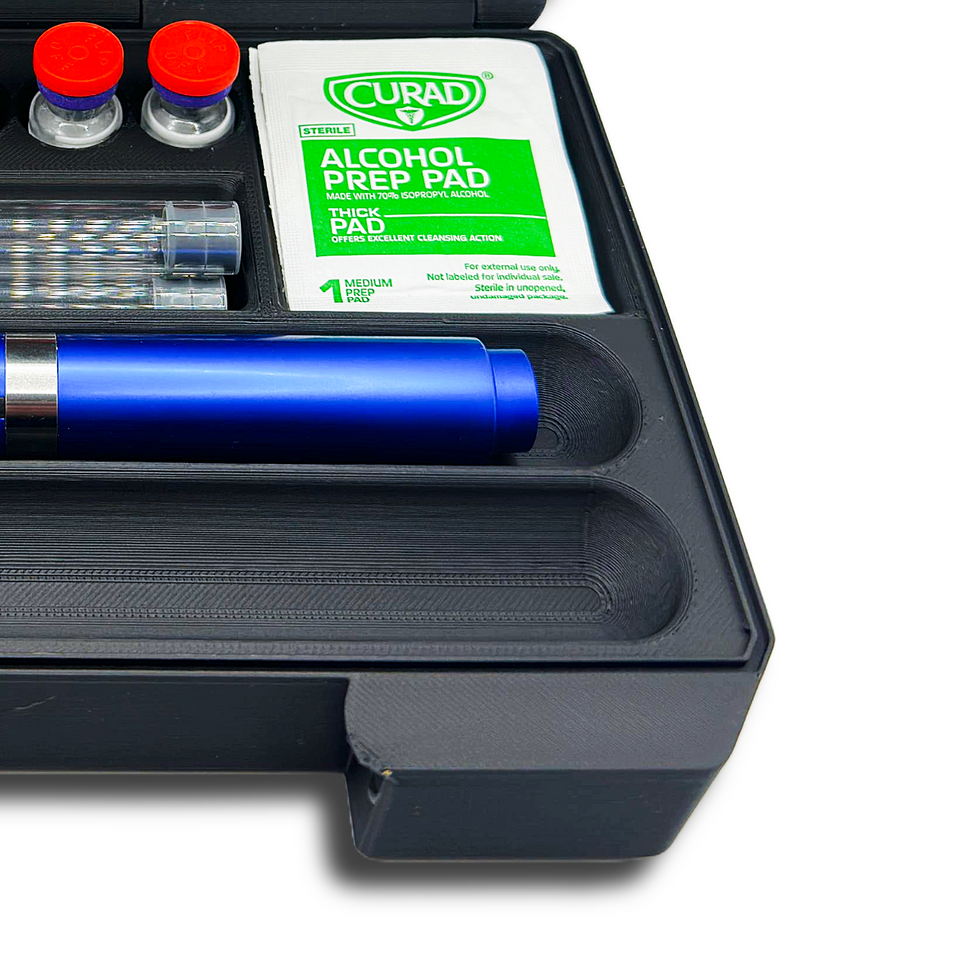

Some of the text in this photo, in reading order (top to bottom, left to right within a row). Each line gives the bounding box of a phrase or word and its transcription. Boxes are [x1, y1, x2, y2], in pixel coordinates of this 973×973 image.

[344, 81, 471, 108] CURAD
[303, 126, 351, 135] STERILE
[320, 146, 474, 168] ALCOHOL
[323, 168, 491, 191] PREP PAD
[326, 190, 490, 200] MADE WITH 70% ISOPROPYL ALCOHOL
[328, 207, 381, 218] THICK
[330, 217, 385, 235] PAD
[331, 234, 503, 243] OFFERS EXCELLENT CLEANSING ACTION
[481, 263, 518, 271] external
[426, 273, 444, 281] Not
[446, 273, 479, 281] labeled
[481, 273, 494, 281] for
[496, 273, 541, 281] individual
[344, 279, 393, 287] MEDIUM
[474, 283, 504, 292] Sterile
[506, 283, 514, 292] in
[319, 279, 343, 303] 1
[346, 288, 375, 297] PREP
